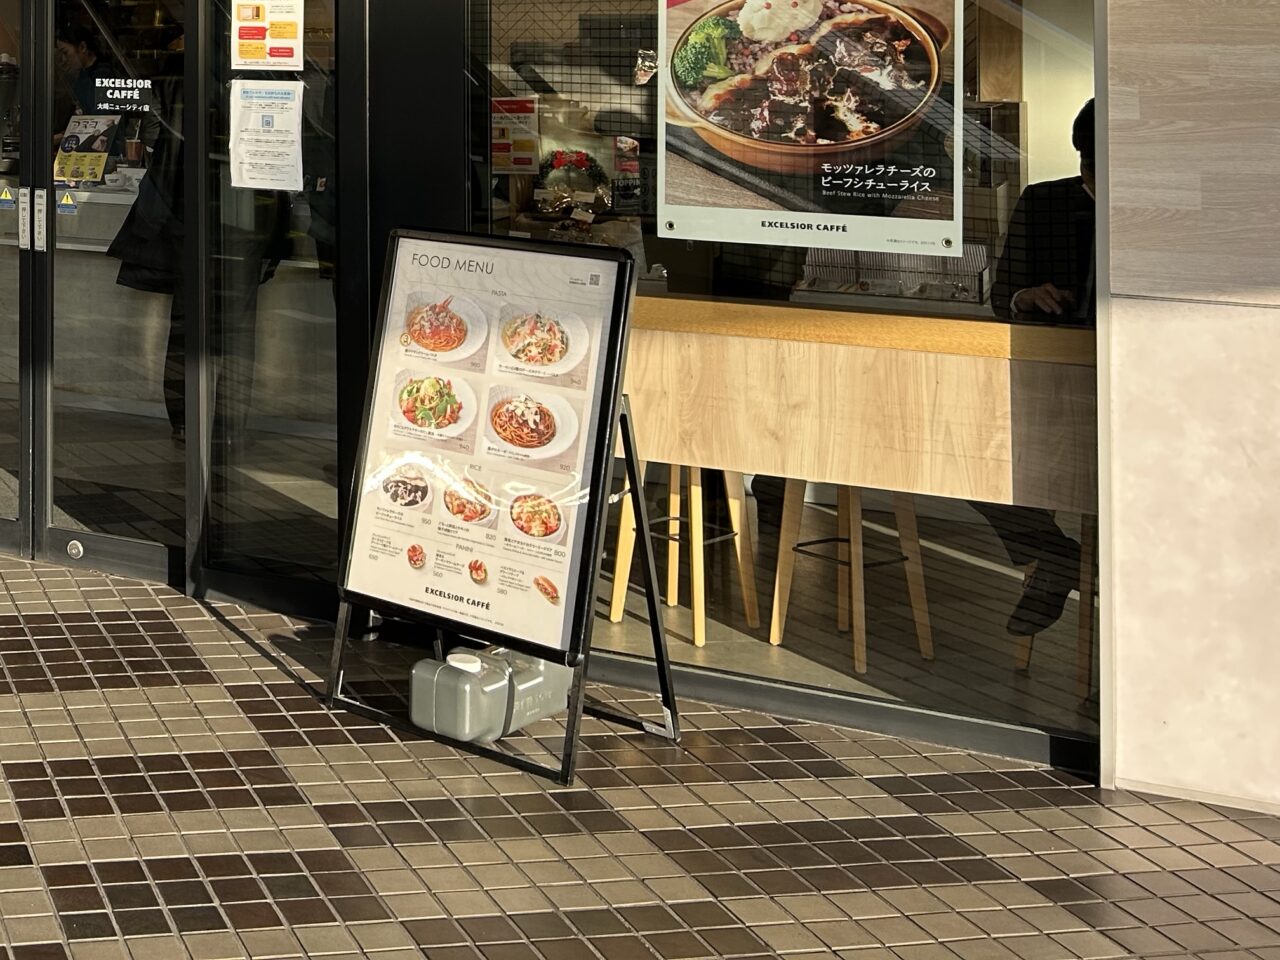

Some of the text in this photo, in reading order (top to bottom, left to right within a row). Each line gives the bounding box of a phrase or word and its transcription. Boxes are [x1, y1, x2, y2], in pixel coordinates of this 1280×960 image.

[95, 78, 152, 89] EXCELSIOR
[106, 88, 140, 100] CAFFÉ
[96, 102, 150, 112] 大崎ニューシティ店
[821, 163, 936, 178] モッツァレラチーズの
[821, 176, 932, 192] ビーフシチューライス
[882, 193, 916, 201] Mozzarella
[917, 194, 939, 202] Cheese
[761, 219, 848, 233] EXCELSIOR CAFFÉ
[411, 253, 495, 275] FOOD MENU
[491, 289, 508, 298] PASTA
[469, 463, 482, 472] RICE
[424, 586, 491, 611] EXCELSIOR CAFFÉ
